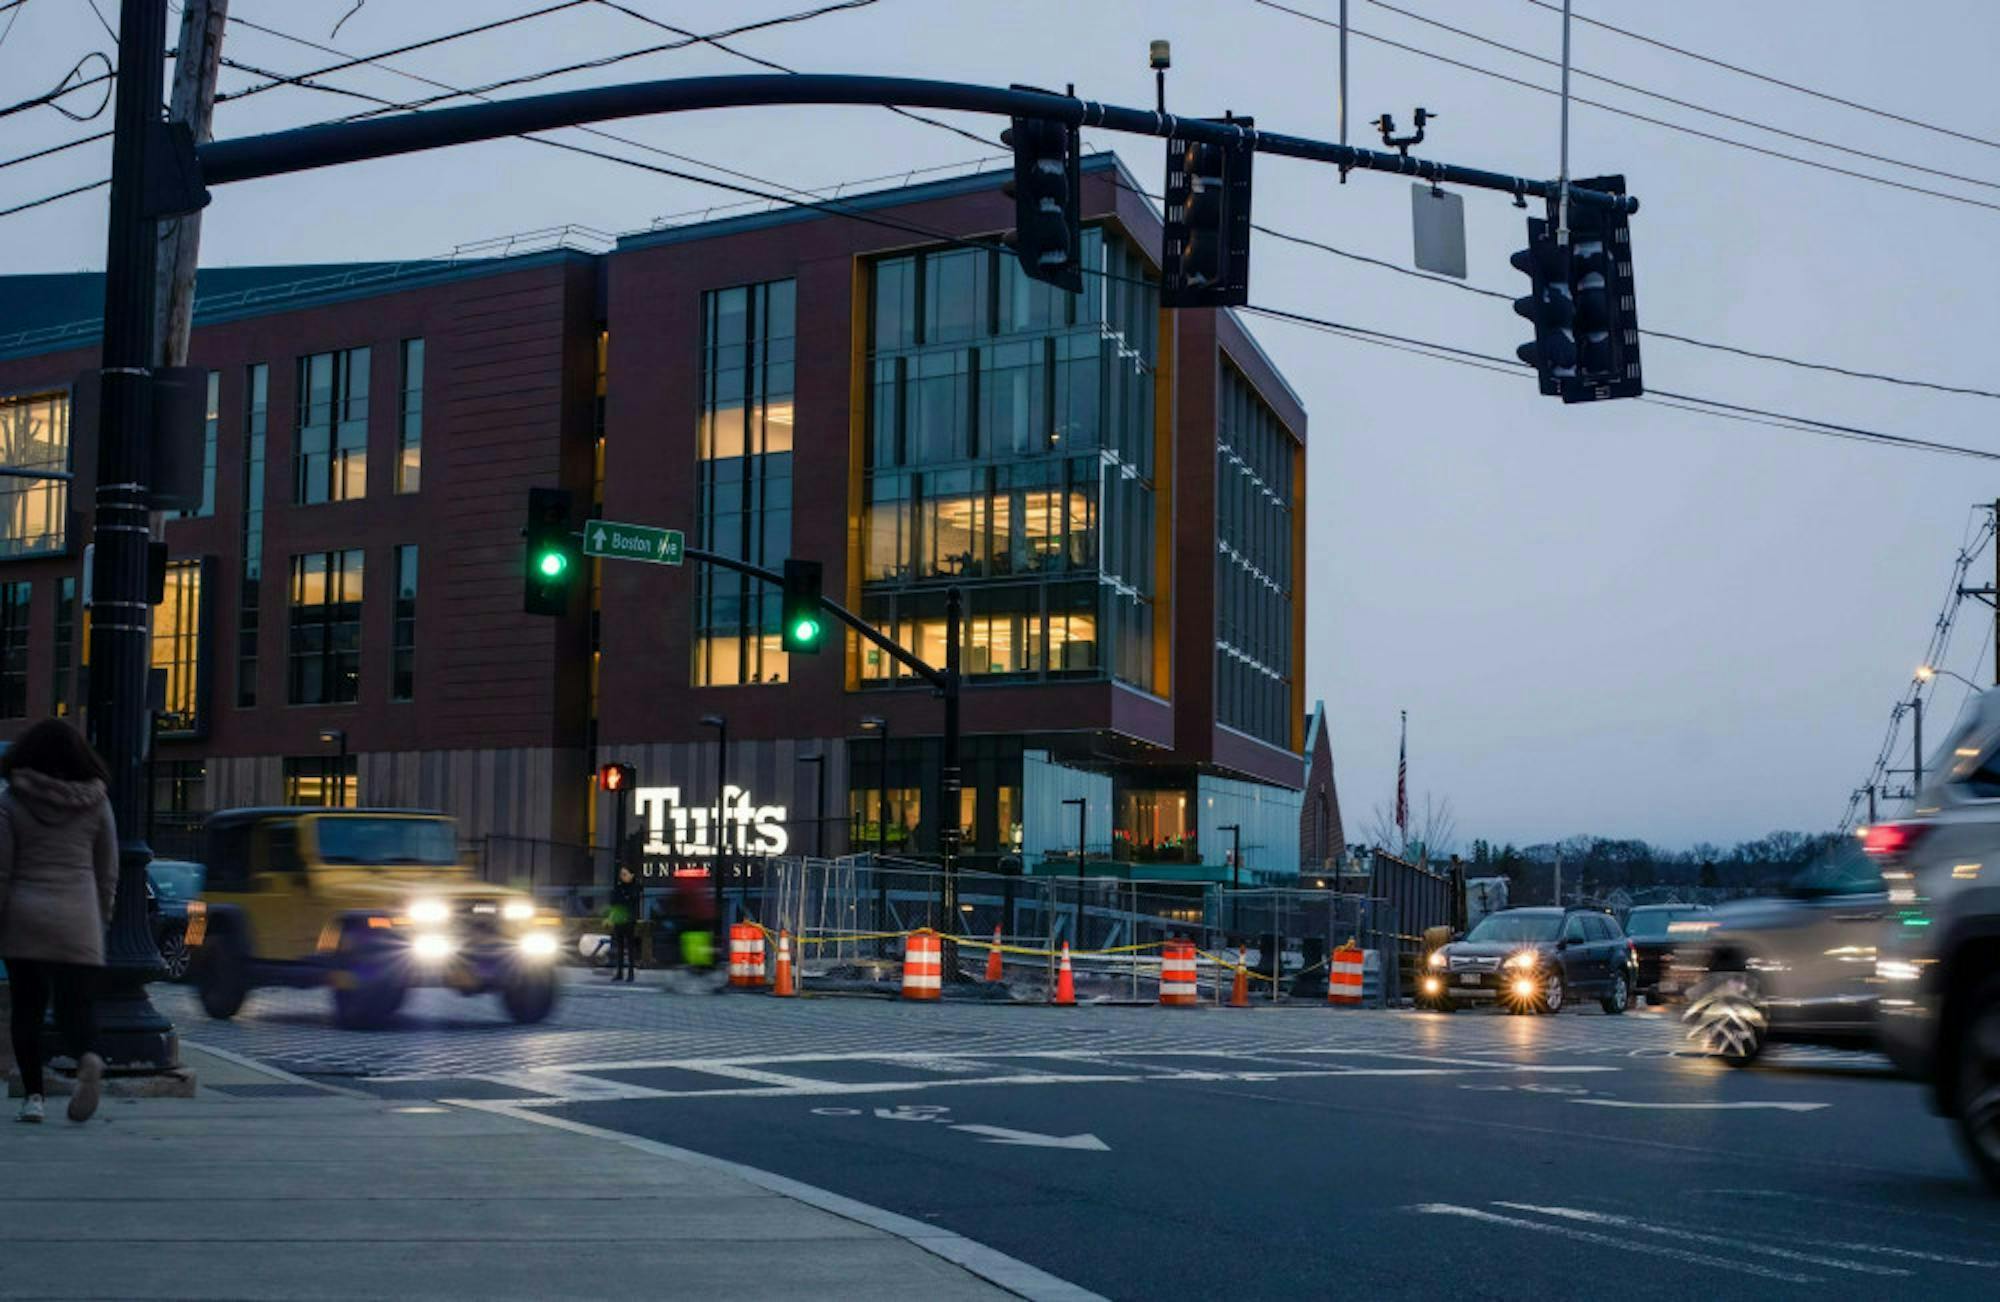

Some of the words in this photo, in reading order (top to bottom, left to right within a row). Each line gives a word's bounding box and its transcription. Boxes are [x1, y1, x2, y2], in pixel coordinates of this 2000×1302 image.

[611, 532, 651, 553] Boston
[657, 538, 678, 556] Ave
[635, 785, 788, 857] Tufts
